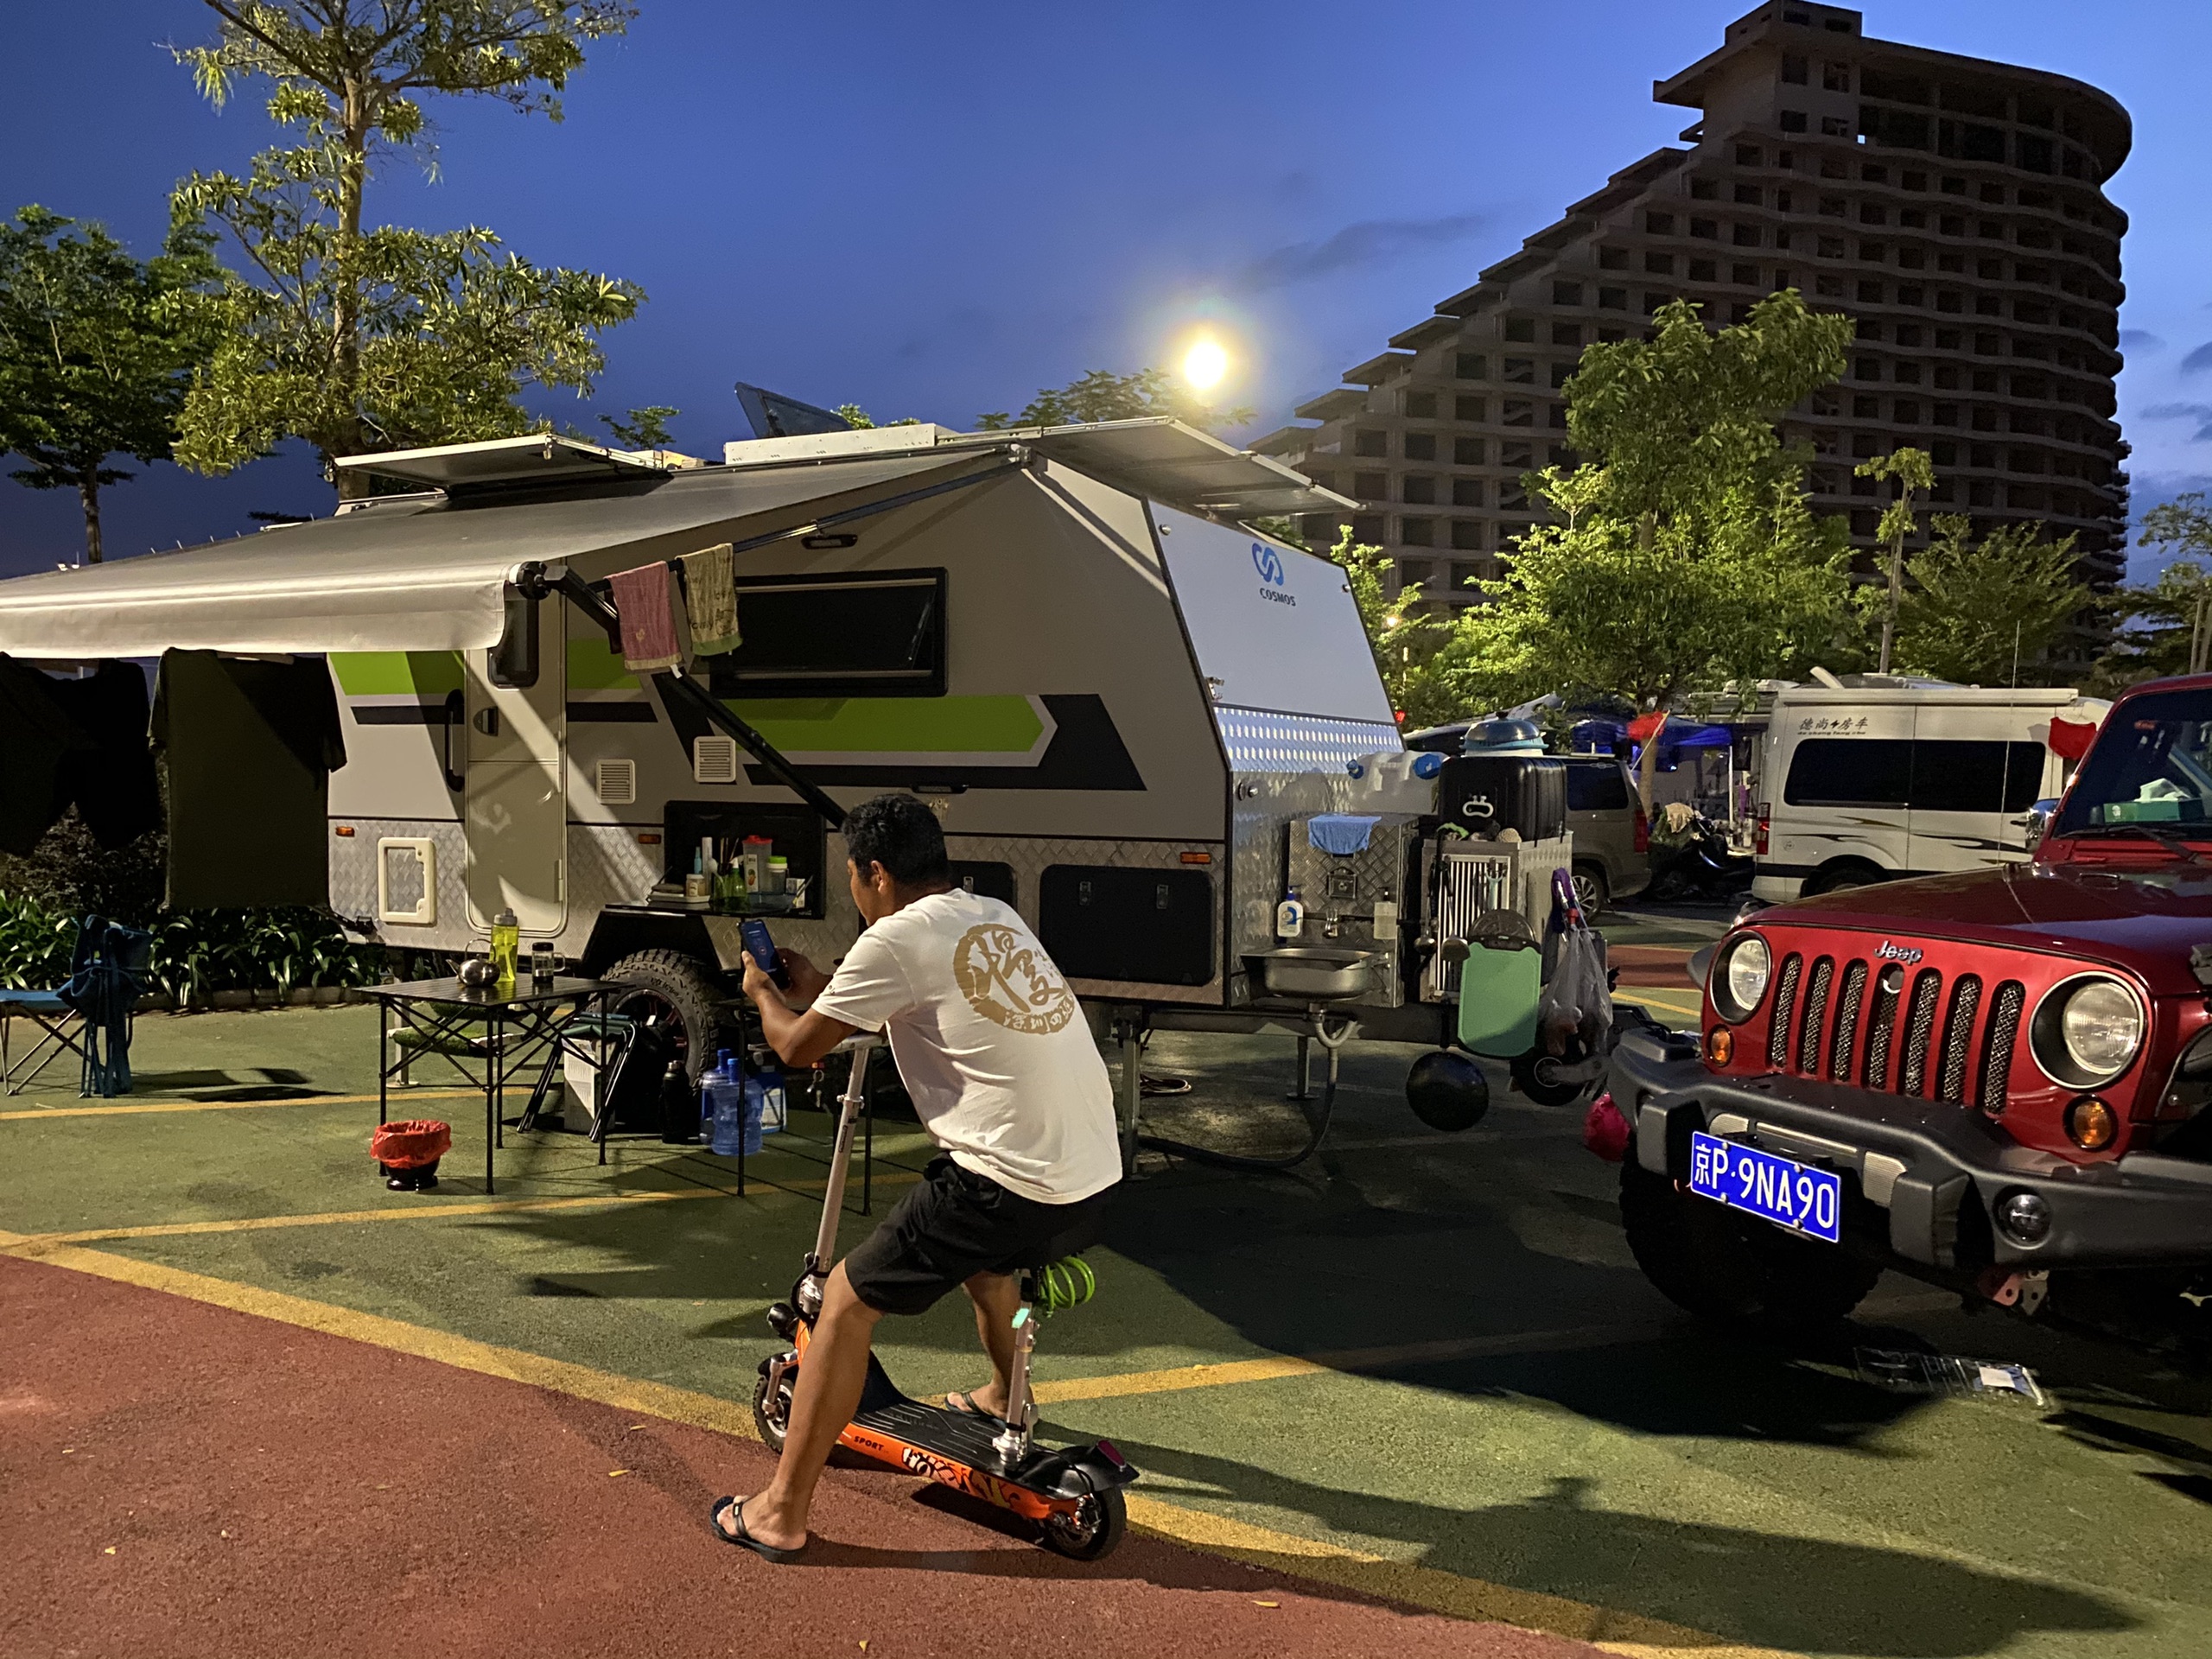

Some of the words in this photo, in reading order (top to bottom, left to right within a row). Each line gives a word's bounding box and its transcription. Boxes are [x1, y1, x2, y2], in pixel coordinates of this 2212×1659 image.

[1260, 588, 1296, 607] COSMOS
[1873, 940, 1923, 965] Jeep
[854, 1435, 885, 1452] SPORT
